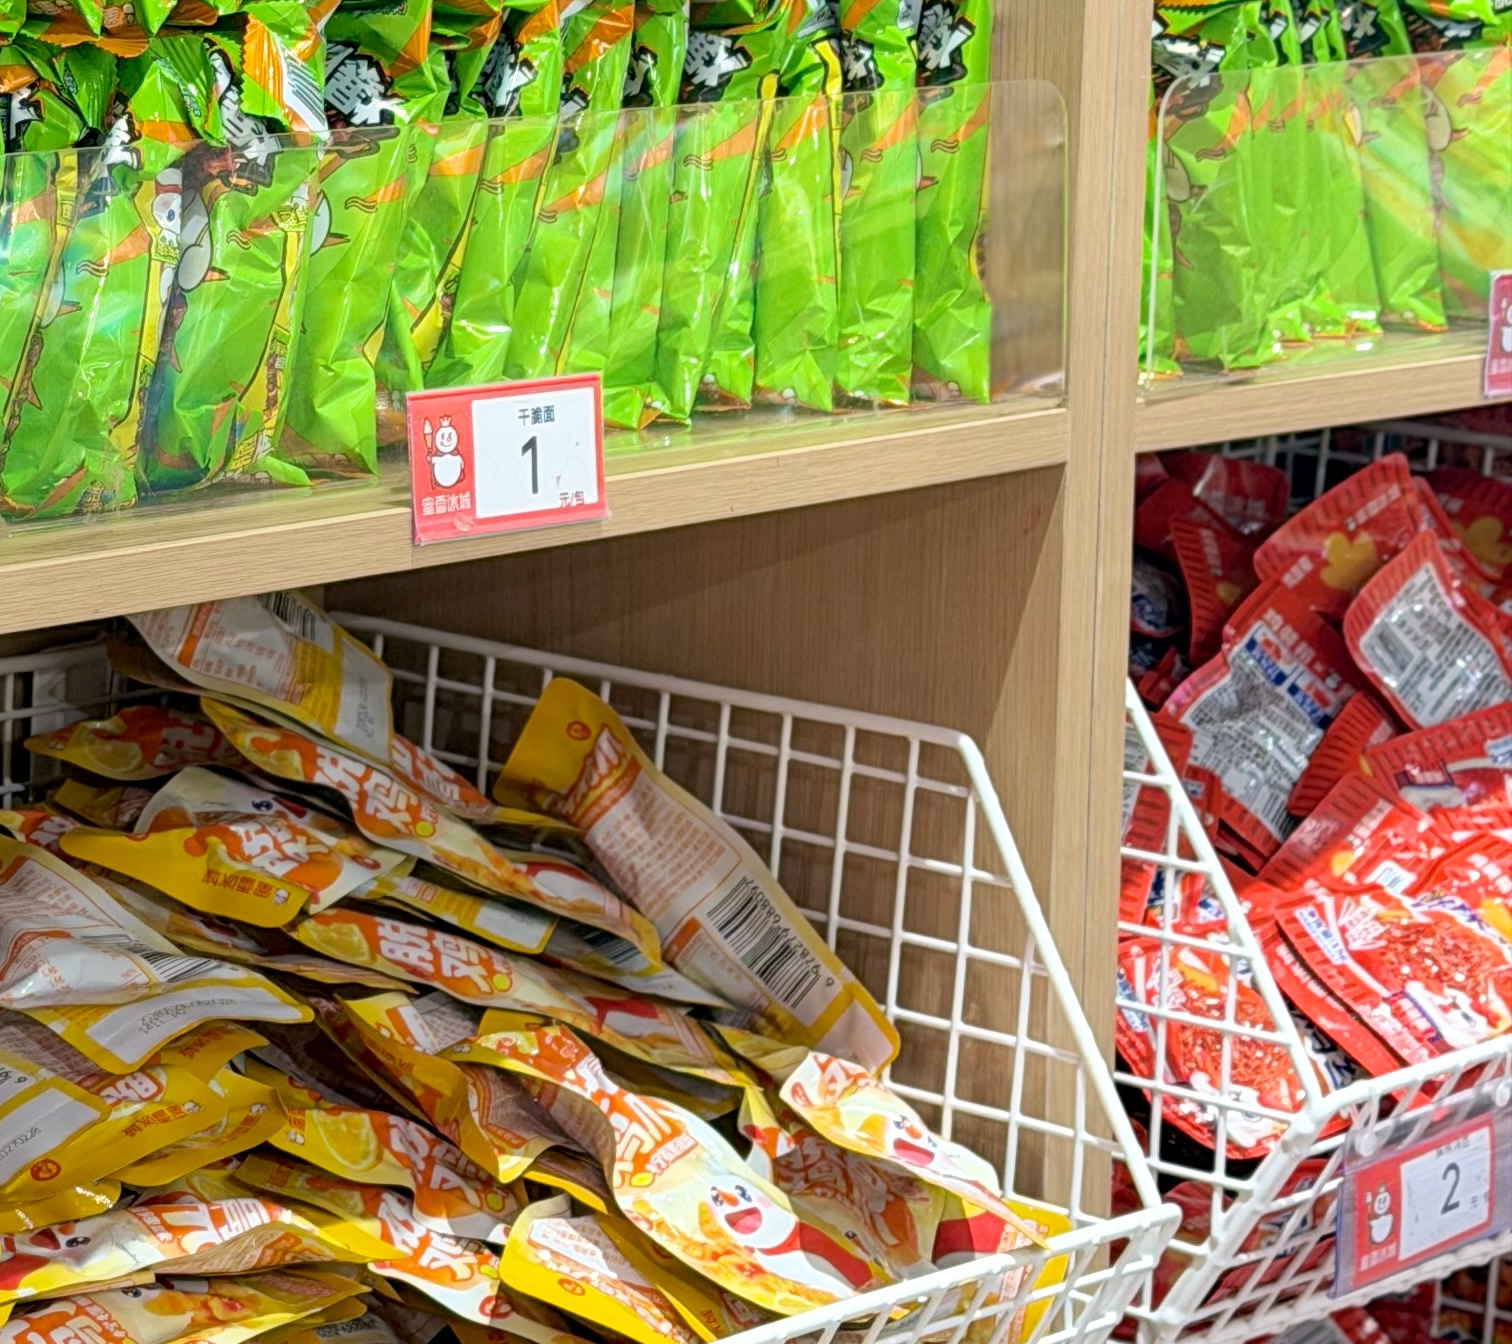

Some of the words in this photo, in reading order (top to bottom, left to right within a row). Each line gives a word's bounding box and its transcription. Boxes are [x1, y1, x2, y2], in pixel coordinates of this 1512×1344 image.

[518, 405, 555, 426] 干脆面
[521, 435, 539, 495] 1
[422, 492, 472, 516] 蜜雪冰城
[1440, 1162, 1461, 1216] 2
